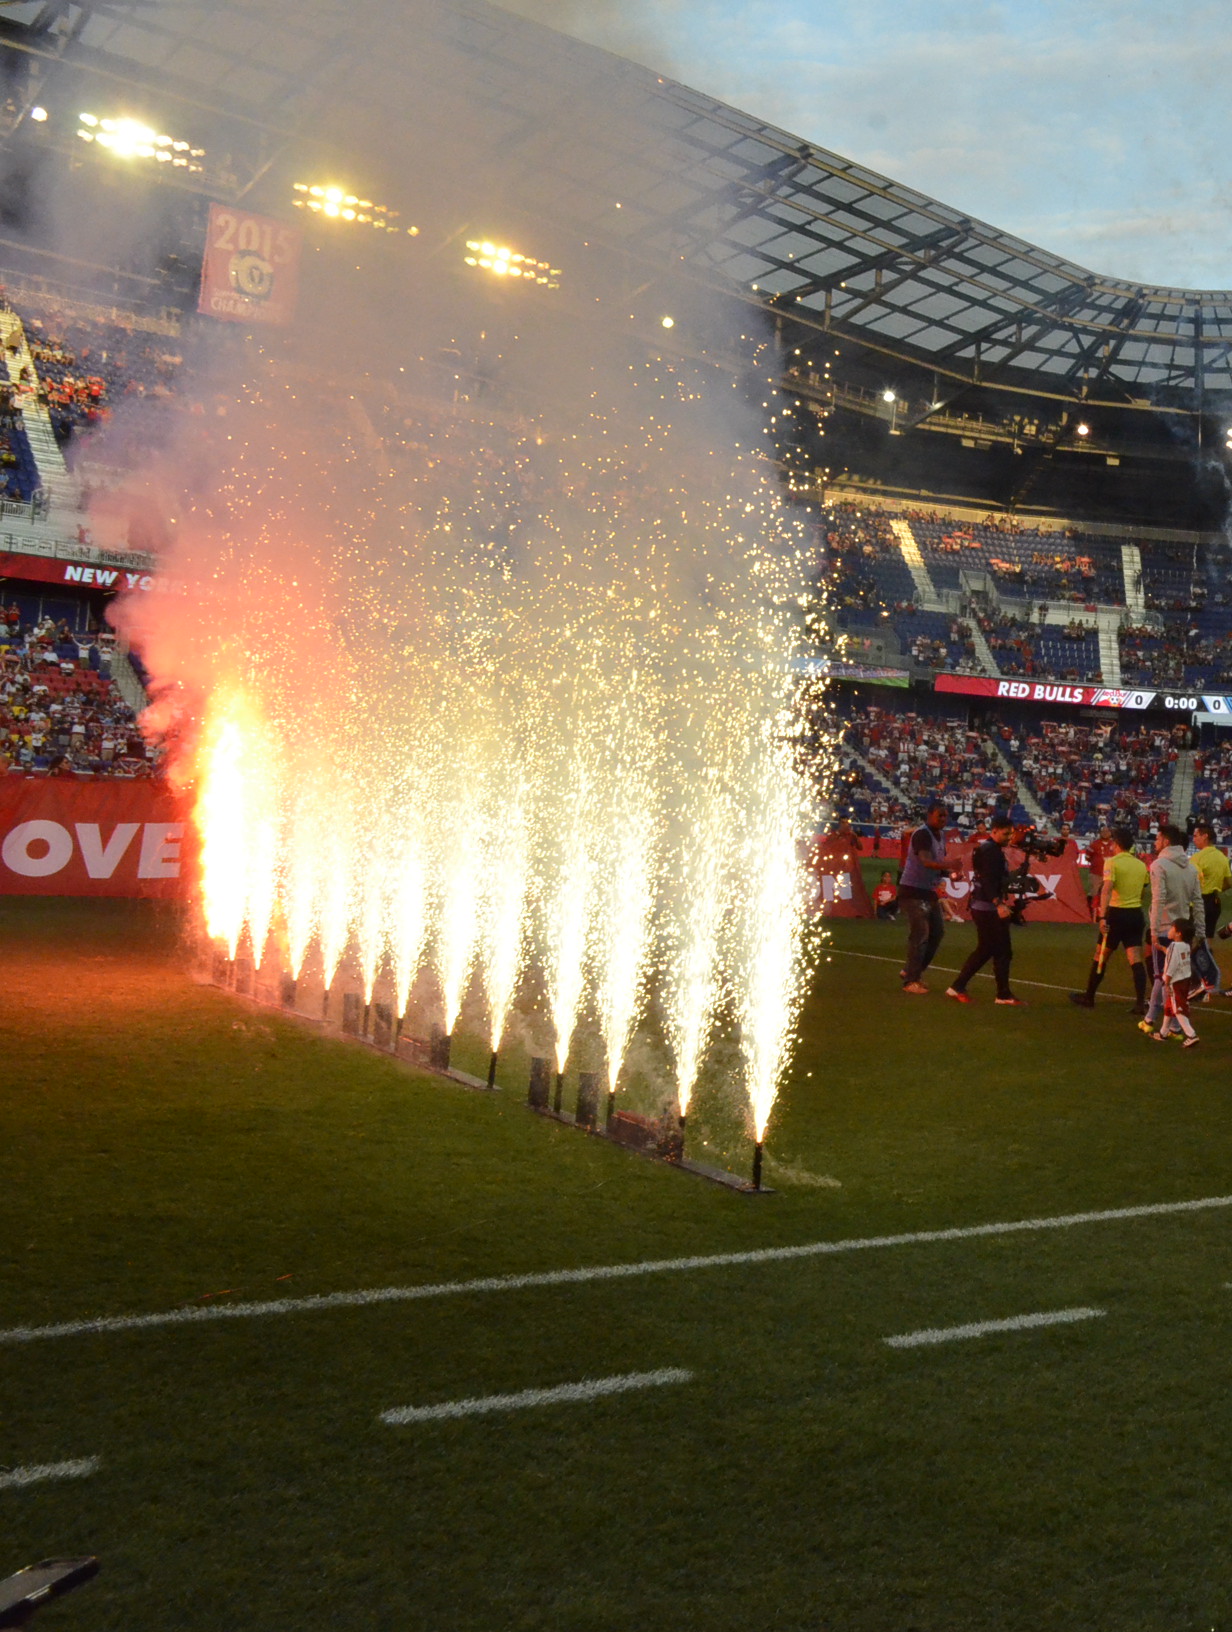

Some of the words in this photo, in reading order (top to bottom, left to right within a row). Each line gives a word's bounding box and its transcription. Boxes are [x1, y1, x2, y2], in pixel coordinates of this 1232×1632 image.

[213, 213, 297, 264] 2015
[64, 565, 118, 587] NEW
[998, 681, 1030, 698] RED
[1034, 685, 1084, 703] BULLS
[1135, 696, 1143, 706] 0
[1165, 697, 1197, 710] 0:00
[1213, 699, 1221, 711] 0
